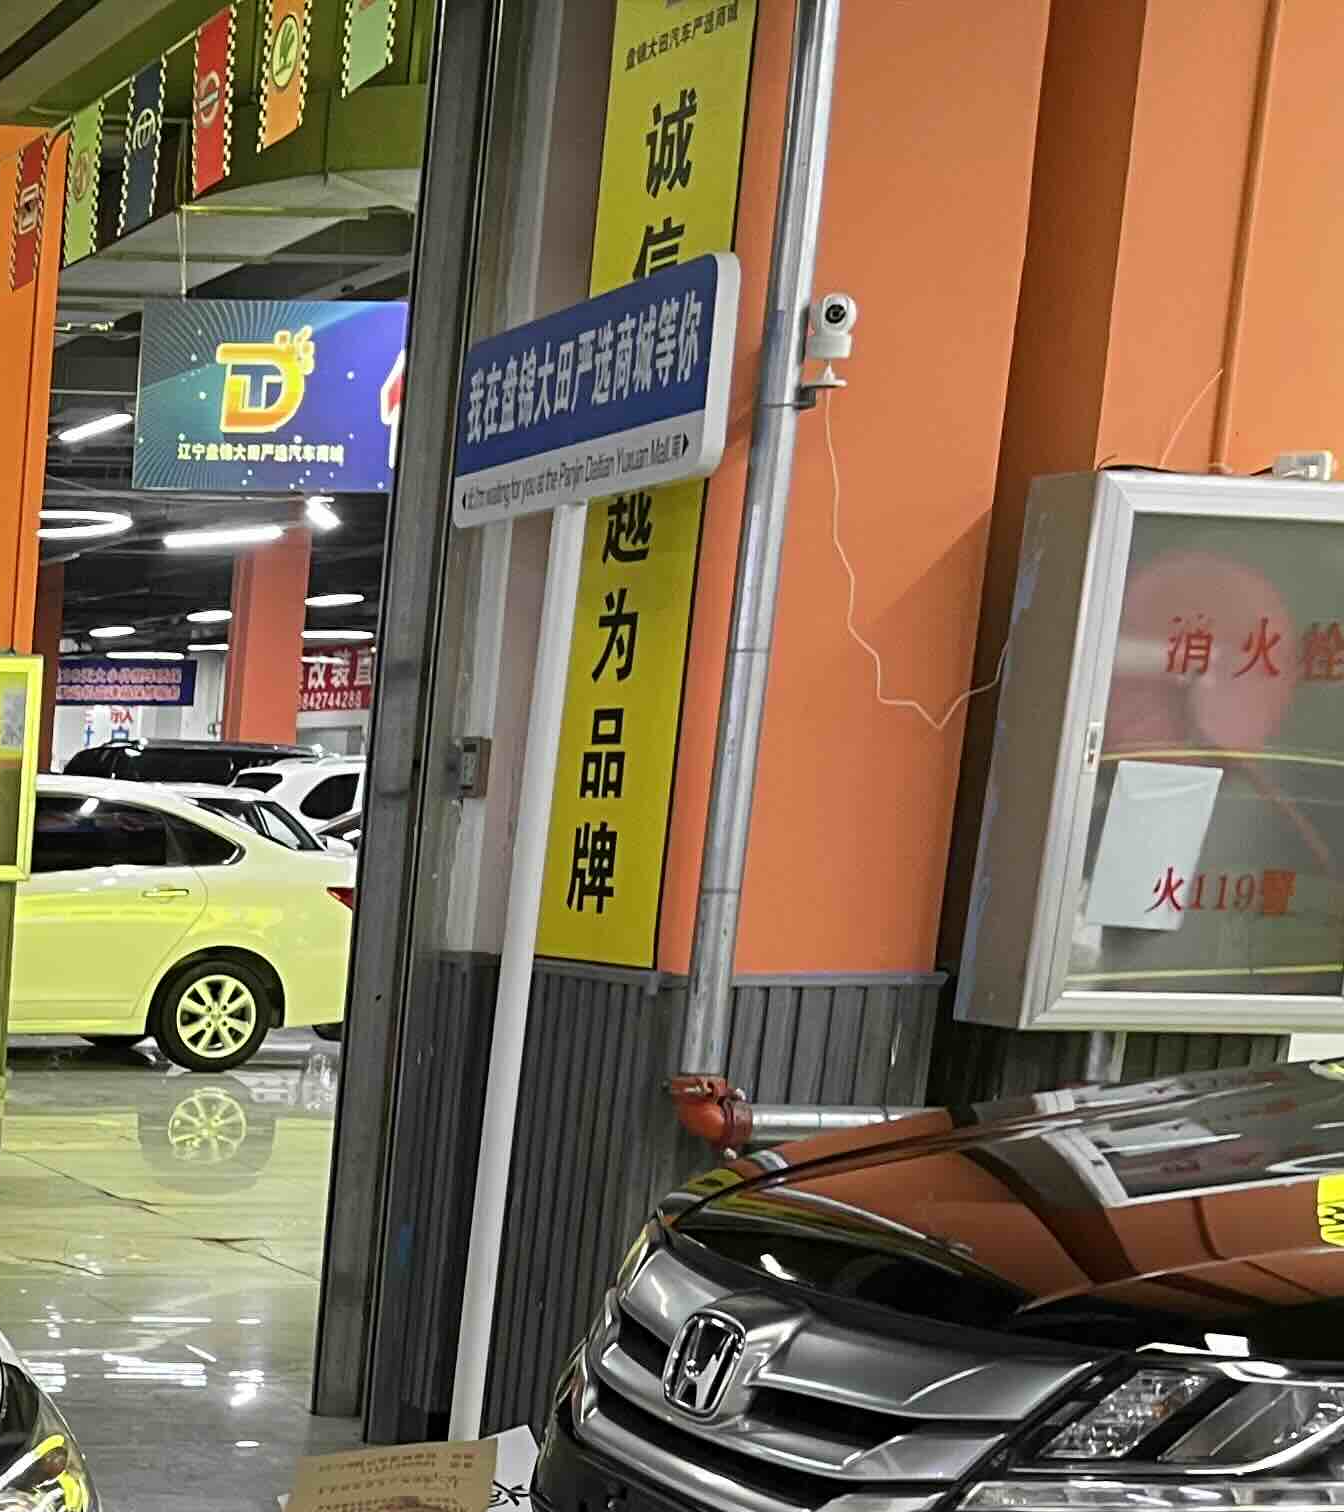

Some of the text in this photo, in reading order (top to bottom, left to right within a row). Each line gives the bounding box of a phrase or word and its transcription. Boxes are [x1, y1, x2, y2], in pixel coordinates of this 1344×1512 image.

[467, 289, 703, 445] 我在盘锦大田严选商城等你
[1144, 865, 1298, 916] 火119警
